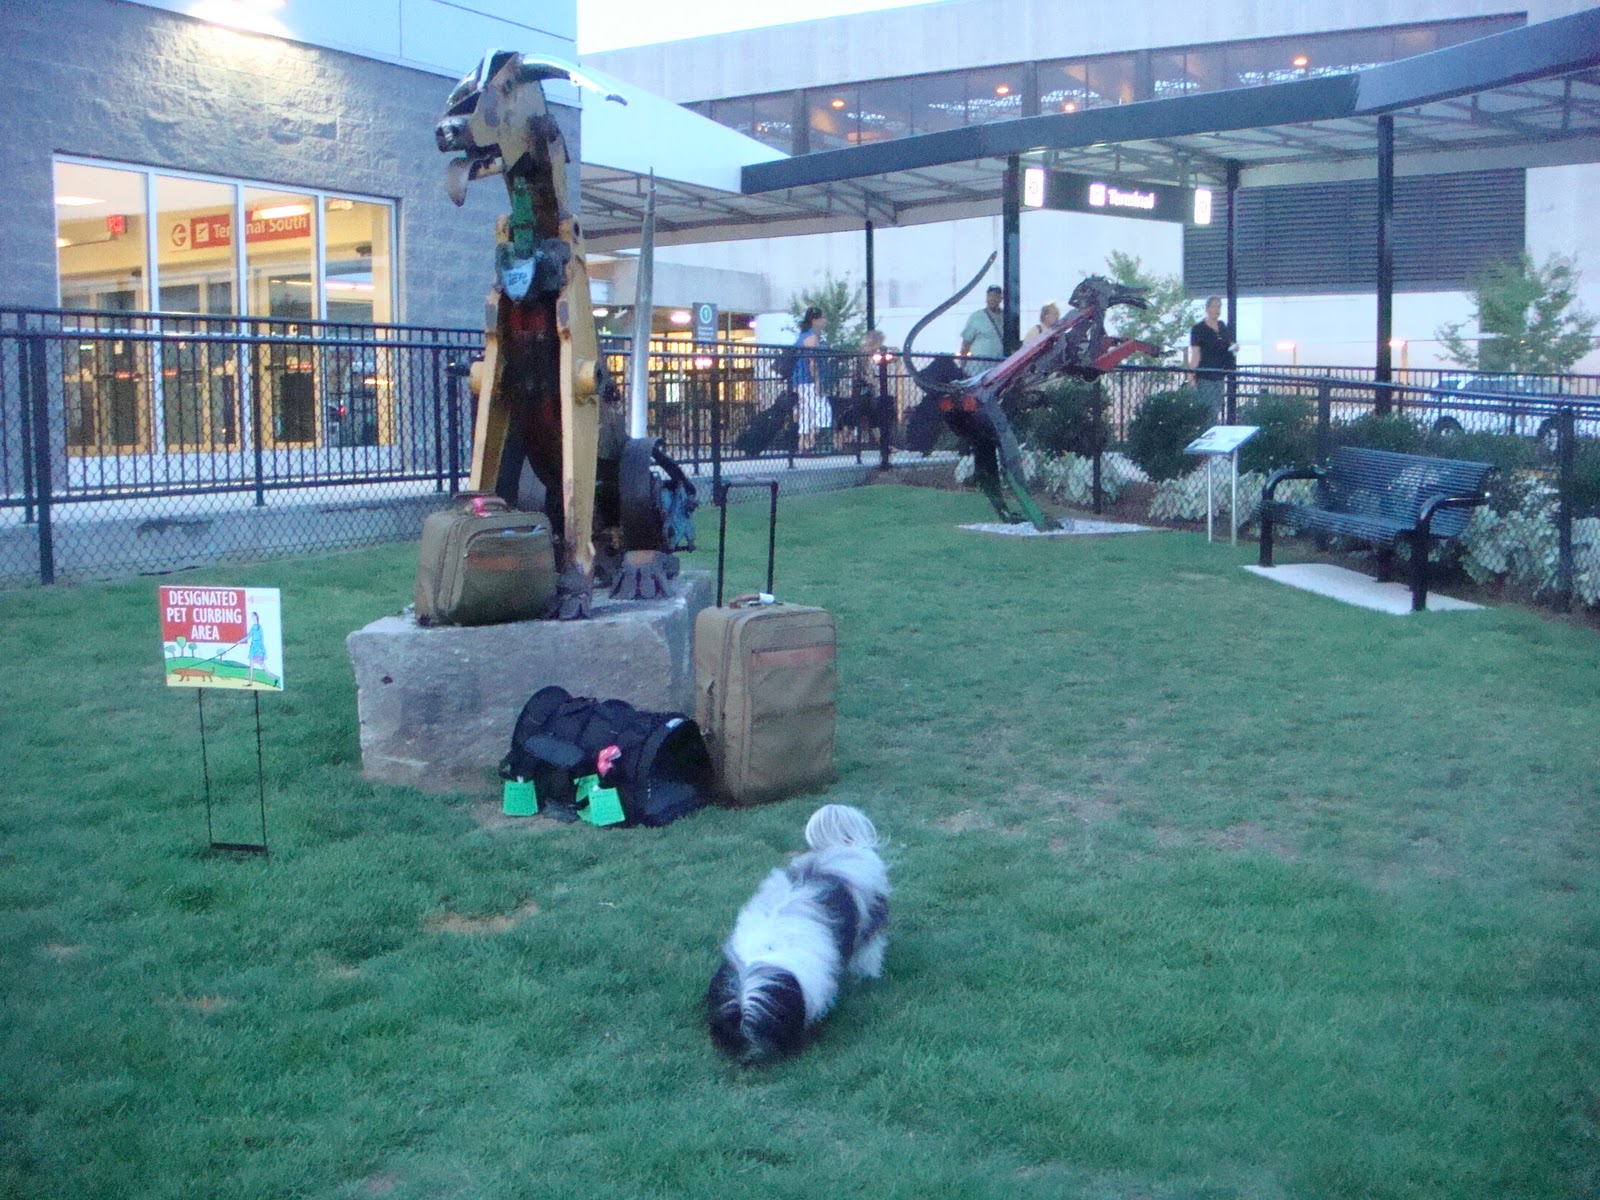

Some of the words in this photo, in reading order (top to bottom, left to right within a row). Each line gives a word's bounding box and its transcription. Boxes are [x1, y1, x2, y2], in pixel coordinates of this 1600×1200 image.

[212, 219, 266, 239] Ternal
[269, 216, 307, 233] South
[168, 590, 238, 607] DESIGNATED
[166, 607, 187, 623] PET
[192, 607, 243, 624] CURBING
[191, 625, 220, 641] AREA
